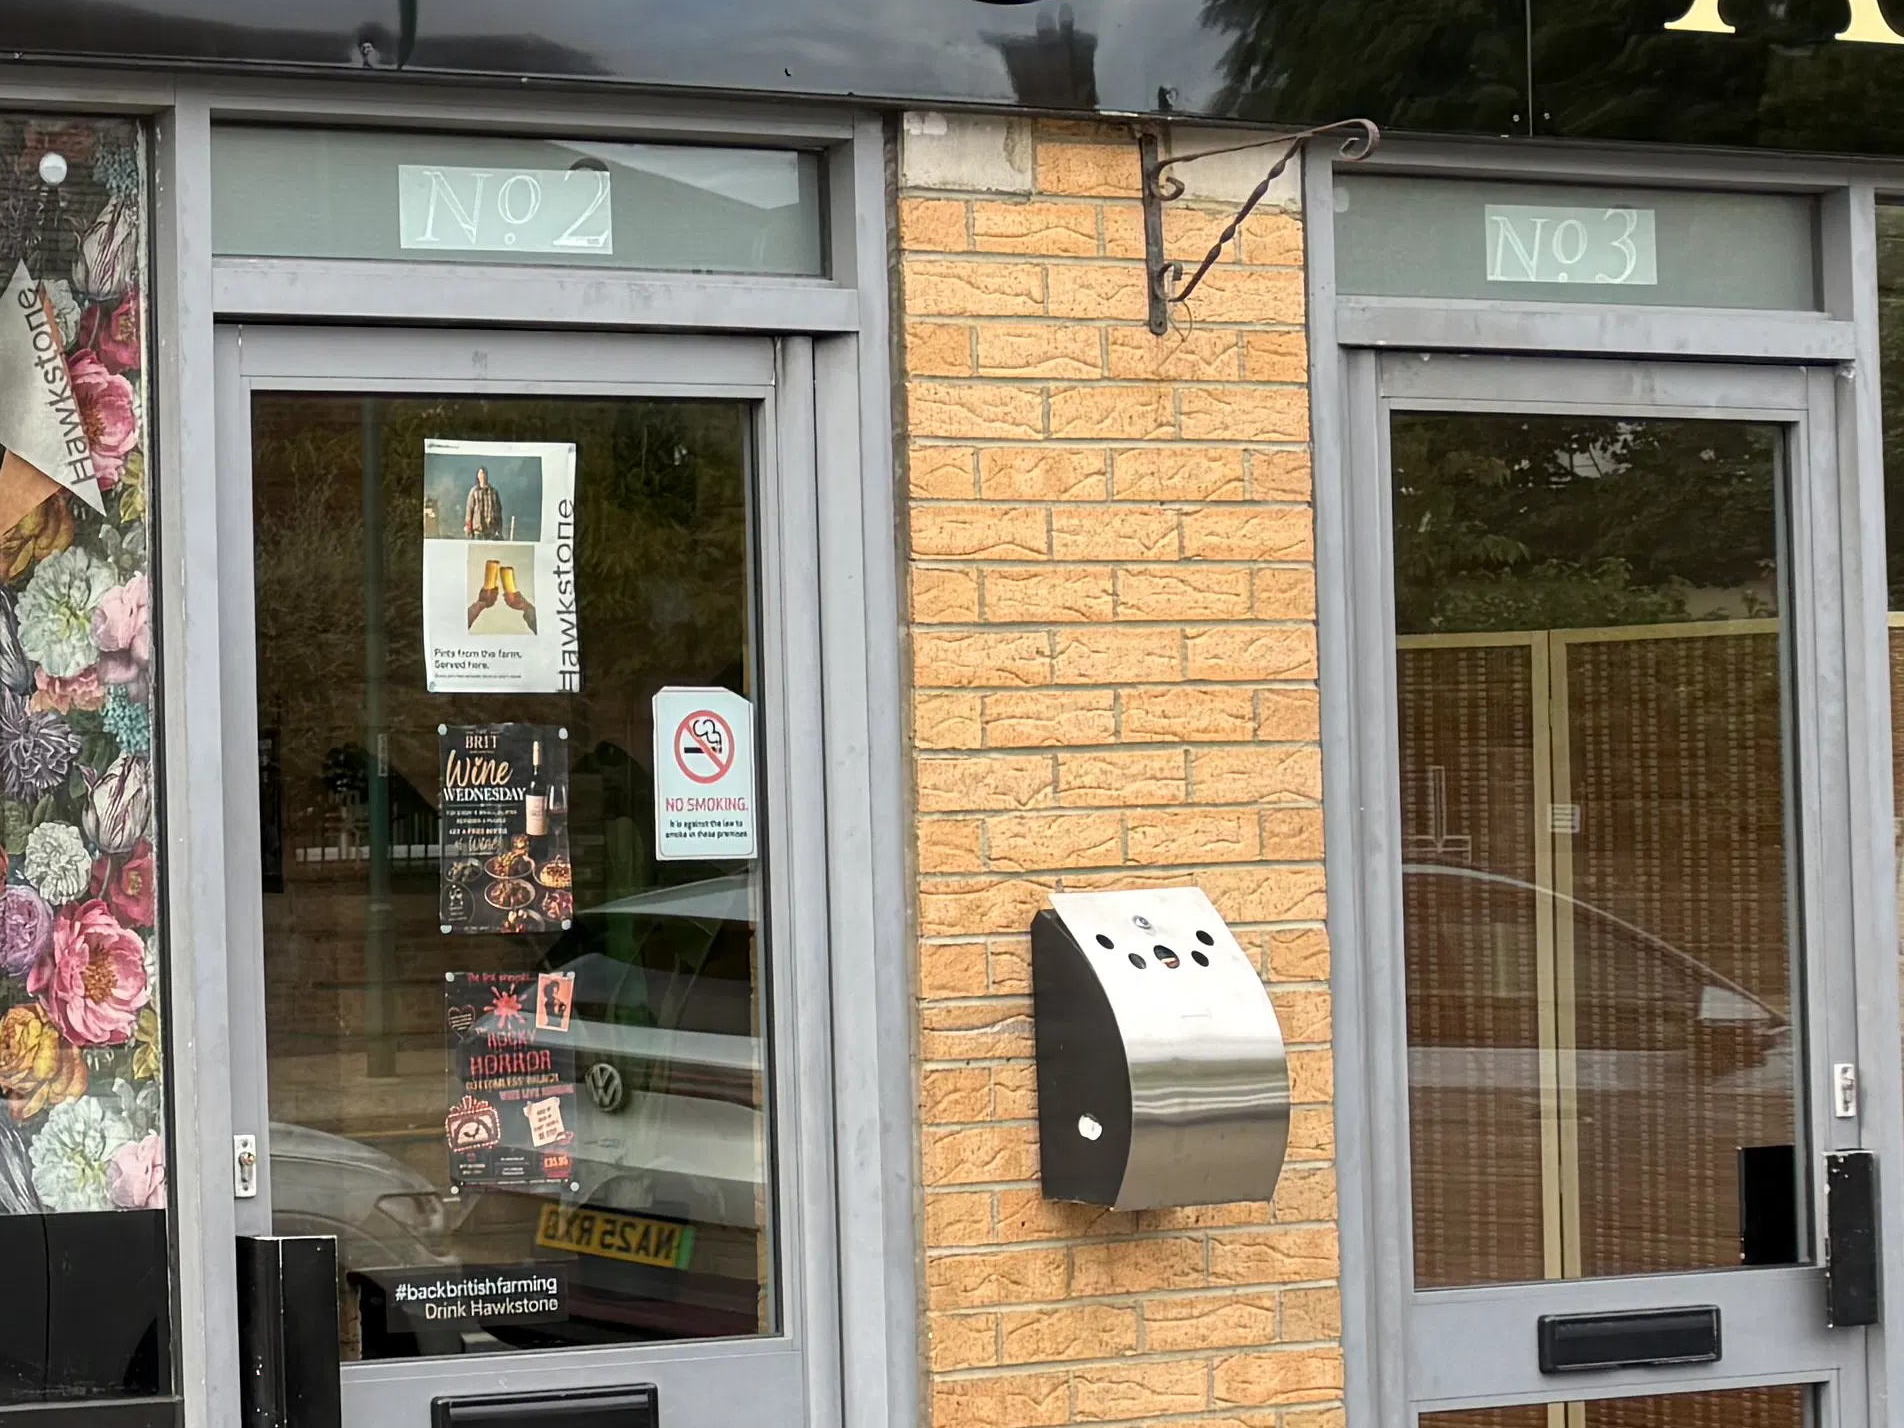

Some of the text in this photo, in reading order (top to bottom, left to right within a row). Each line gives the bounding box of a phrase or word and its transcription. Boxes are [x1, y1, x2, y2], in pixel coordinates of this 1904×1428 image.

[17, 288, 96, 486] Hawkstone
[552, 499, 580, 693] Hawkstone
[465, 735, 498, 749] BRIT
[446, 749, 513, 787] Wine
[443, 787, 526, 802] WEDNESDAY
[666, 798, 684, 812] NO
[488, 1028, 536, 1050] ROCKY
[470, 1049, 551, 1076] HORROR
[395, 1275, 558, 1302] #backbritishfarming
[425, 1296, 559, 1320] Drink Hawkstone
